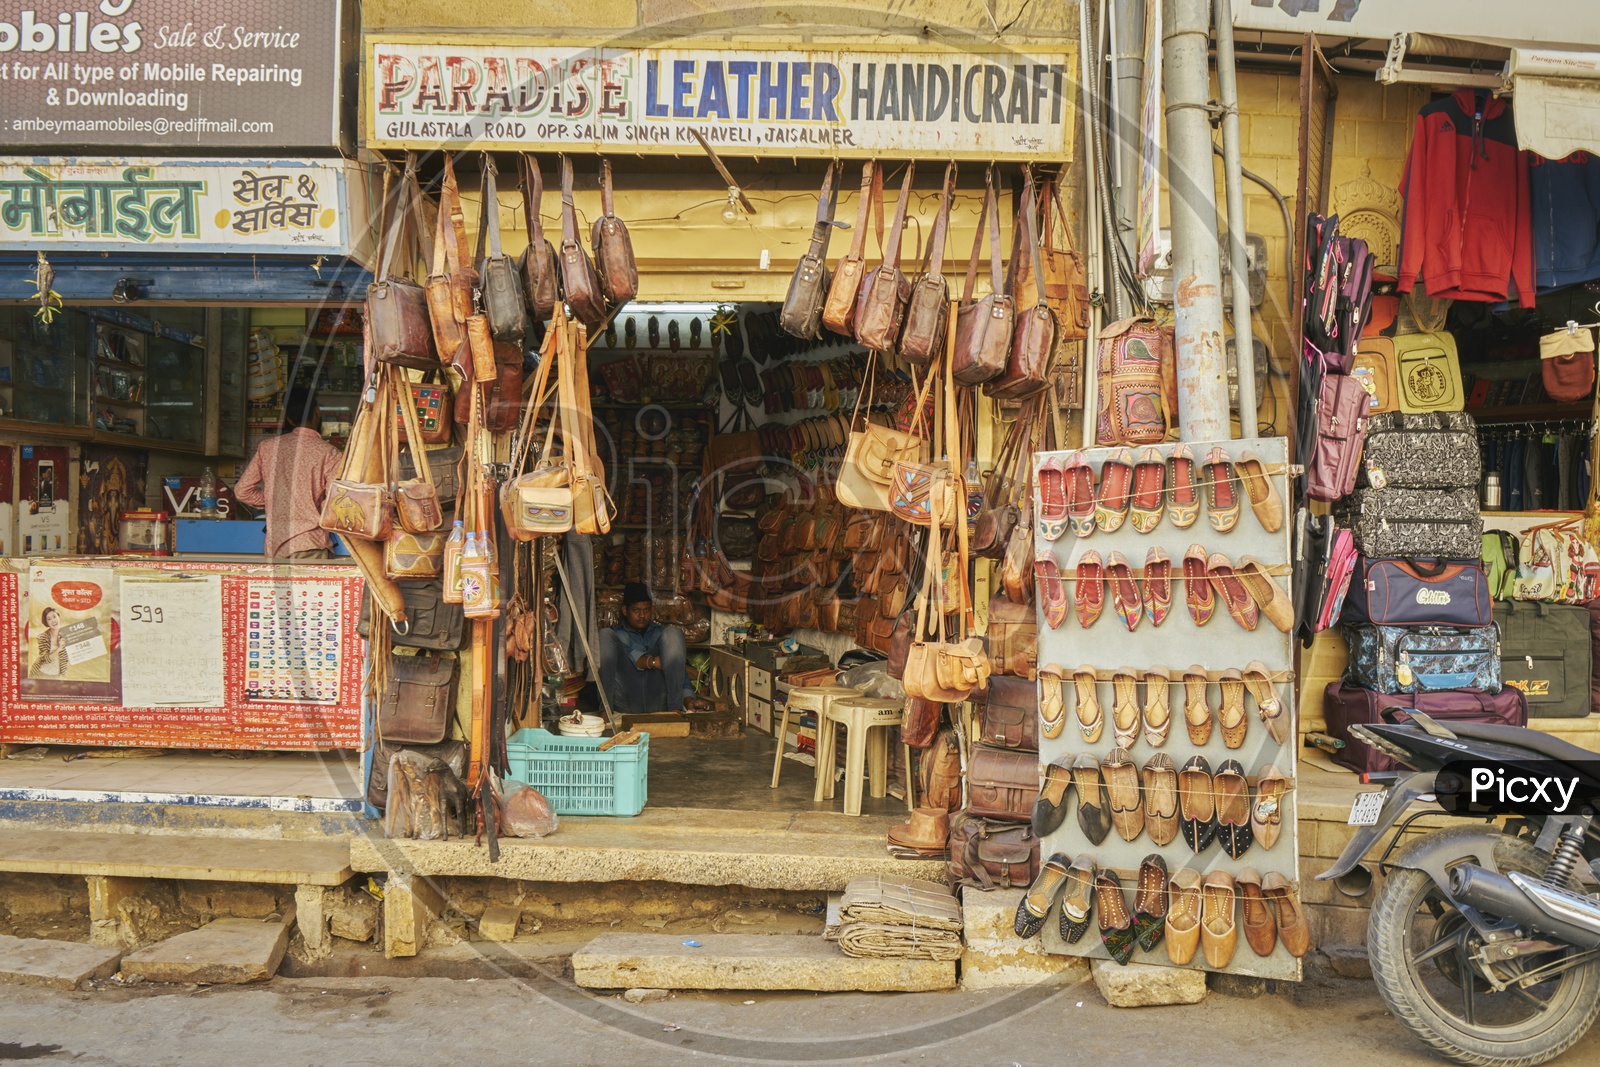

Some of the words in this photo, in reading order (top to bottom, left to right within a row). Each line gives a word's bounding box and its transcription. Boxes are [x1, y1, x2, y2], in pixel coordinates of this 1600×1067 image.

[153, 22, 197, 49] Sale
[203, 24, 226, 49] &
[228, 25, 300, 50] Service
[1531, 54, 1562, 64] Paragon
[13, 62, 40, 80] for
[43, 62, 69, 80] All
[74, 63, 114, 84] type
[119, 63, 139, 80] of
[144, 63, 206, 82] Mobile
[211, 63, 303, 87] Repairing
[46, 89, 60, 106] &
[66, 89, 189, 111] Downloading
[378, 54, 633, 121] PARADISE
[646, 59, 842, 124] LEATHER
[851, 62, 1067, 125] HANDICRAFT
[12, 117, 274, 135] ambeymaamobiles@rediffmail.com
[387, 121, 473, 139] GULASTALA
[485, 122, 526, 139] ROAD
[537, 122, 570, 139] OPP.
[573, 125, 619, 140] SALIM
[626, 126, 670, 141] SINGH
[765, 127, 857, 147] JAISALMER
[232, 170, 291, 204] सेल
[297, 174, 318, 202] &
